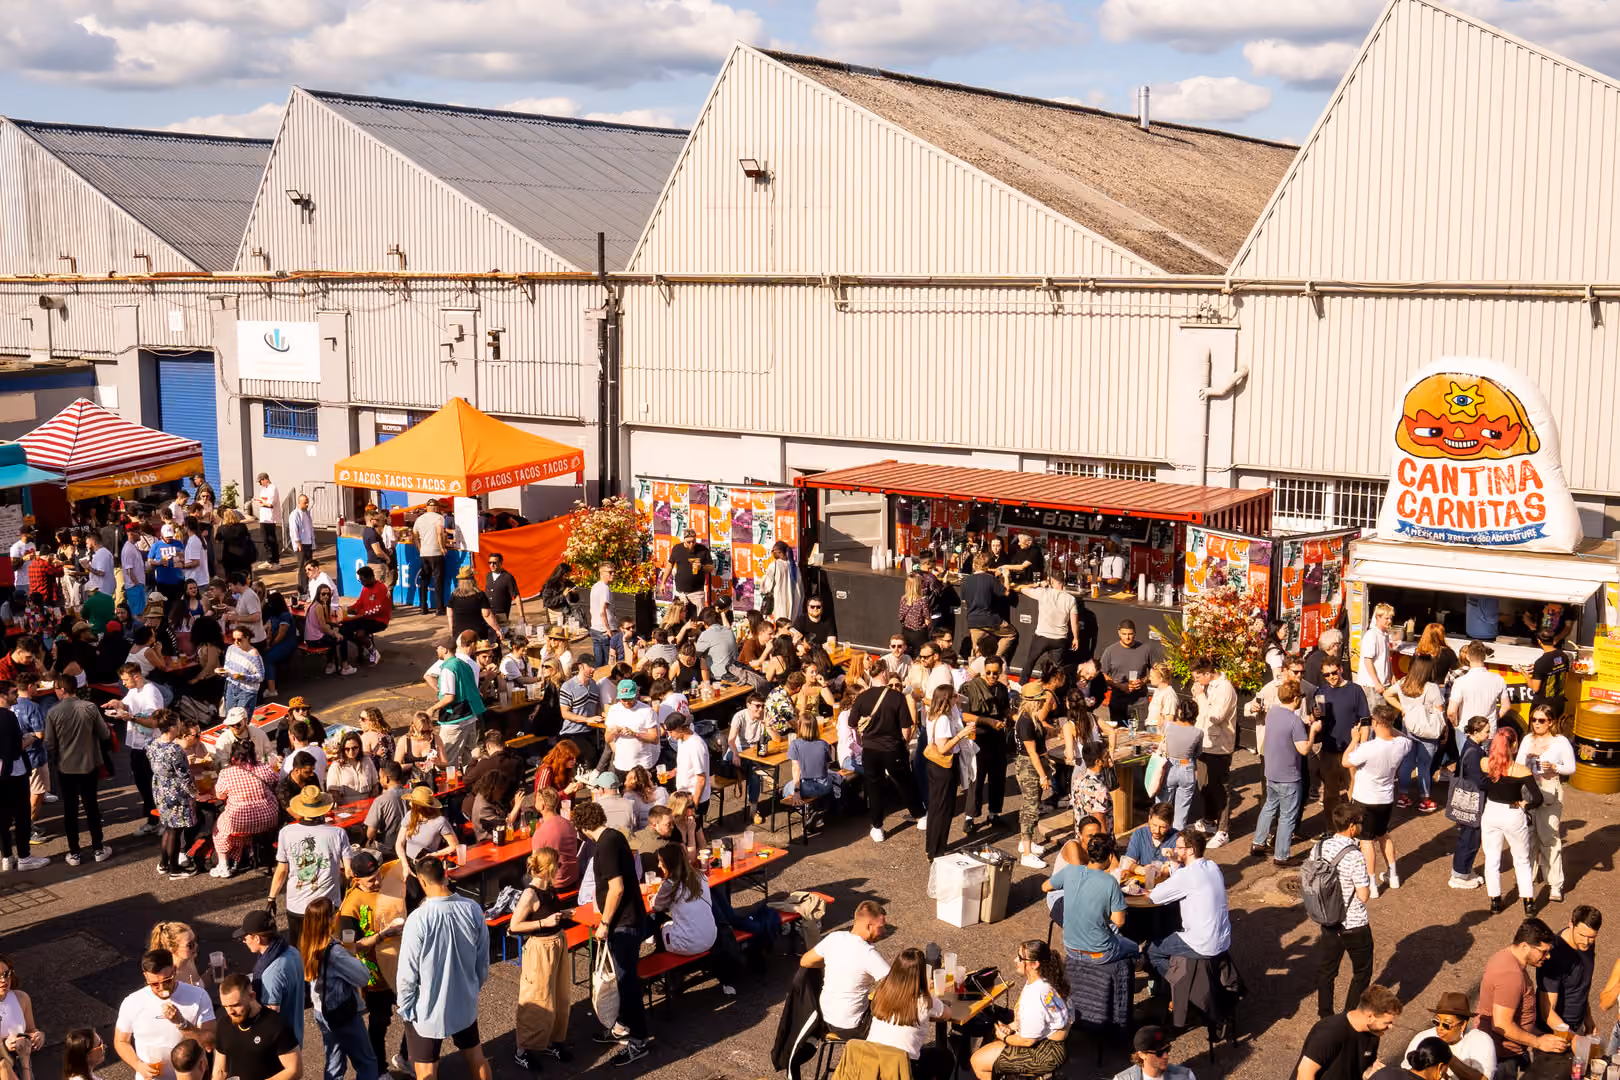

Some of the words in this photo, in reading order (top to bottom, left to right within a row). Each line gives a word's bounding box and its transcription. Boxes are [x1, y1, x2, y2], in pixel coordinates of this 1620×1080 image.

[112, 472, 158, 488] TACOS
[353, 471, 381, 485] TACOS
[384, 474, 413, 489] TACOS
[416, 477, 446, 491] TACOS
[485, 472, 512, 488] TACOS
[514, 465, 541, 481] TACOS
[543, 459, 568, 474] TACOS
[1043, 512, 1104, 531] BREW
[1411, 528, 1446, 541] MEXICAN
[1472, 534, 1490, 543] FOOD
[1490, 528, 1537, 542] ADVENTURE
